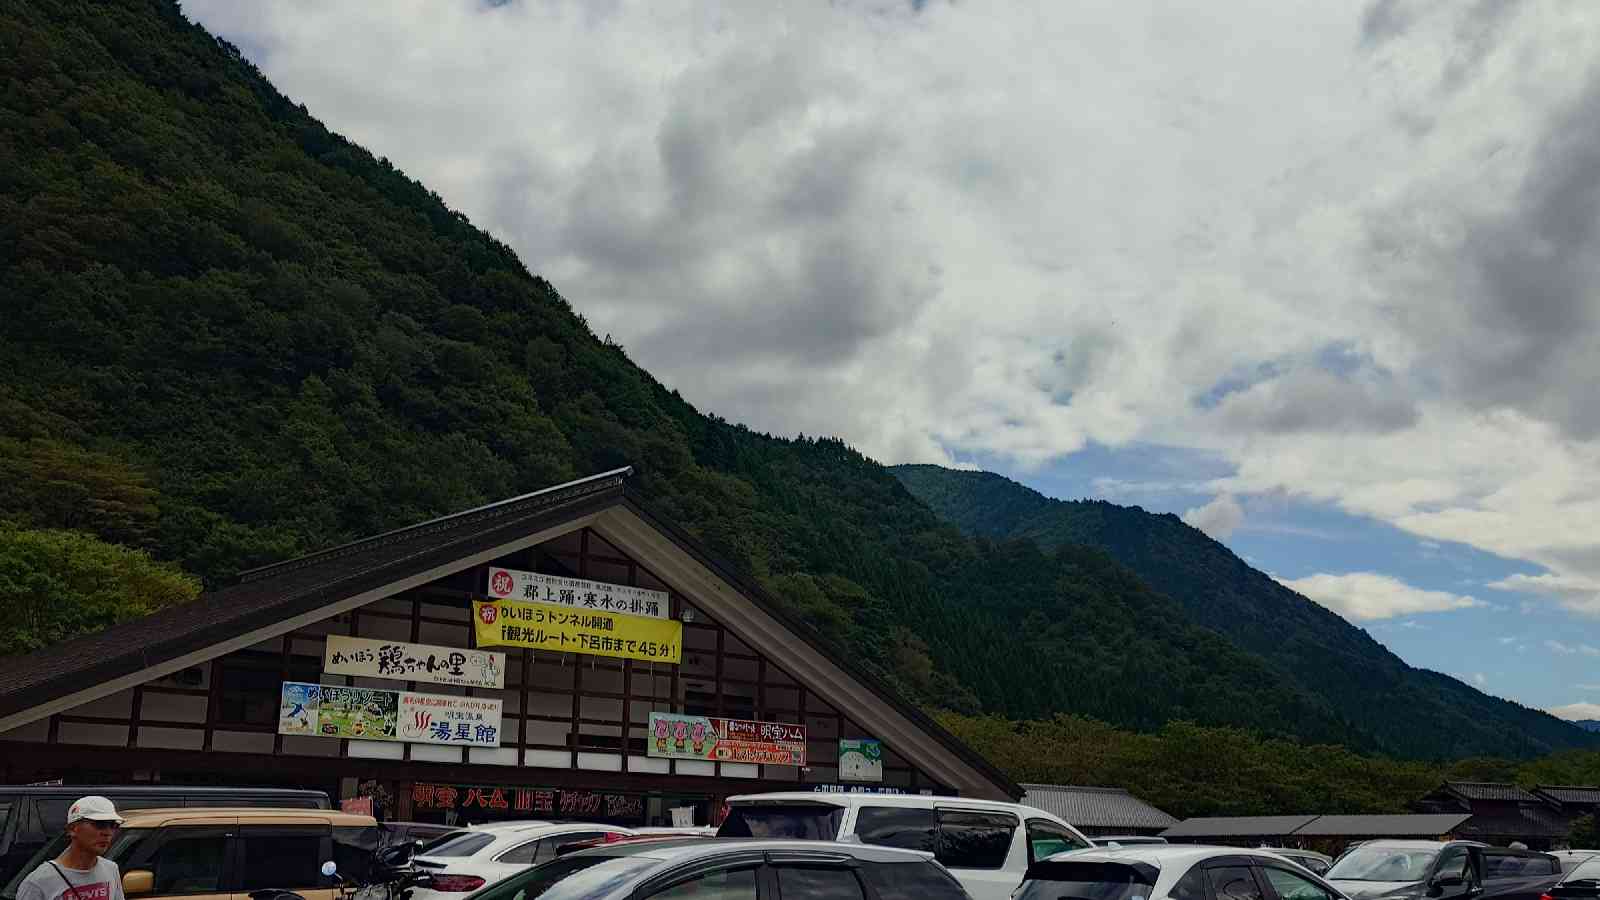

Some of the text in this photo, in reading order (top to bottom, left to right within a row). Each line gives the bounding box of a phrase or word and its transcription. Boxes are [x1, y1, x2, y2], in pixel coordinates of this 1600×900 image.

[494, 574, 511, 595] 祝
[523, 584, 659, 617] 郡上踊・寒水の掛踊
[332, 645, 466, 675] めいほう 鶏ちゃんの里
[430, 721, 496, 745] 湯星館
[761, 723, 803, 740] 明宝ハム
